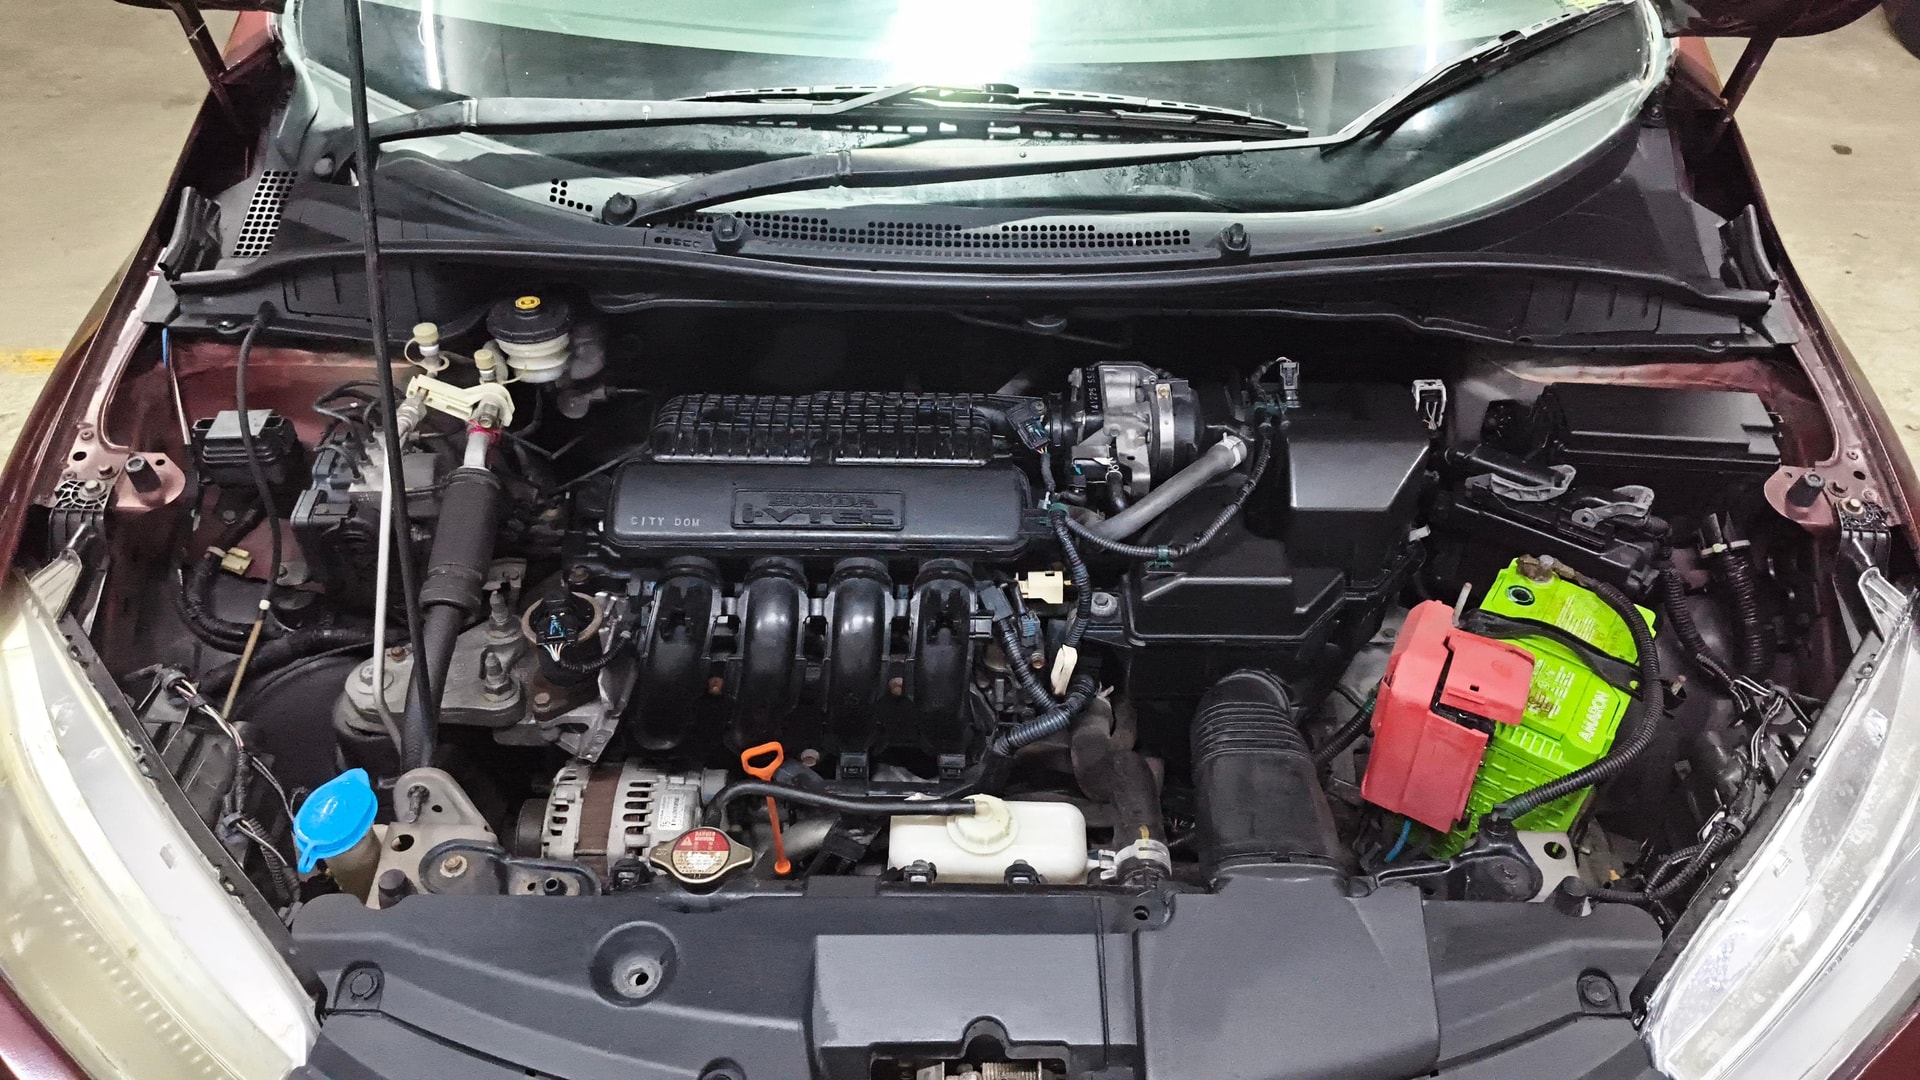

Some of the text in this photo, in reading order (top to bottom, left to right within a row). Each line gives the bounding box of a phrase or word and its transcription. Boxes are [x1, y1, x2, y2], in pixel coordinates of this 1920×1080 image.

[768, 493, 878, 508] HONDA
[630, 516, 700, 527] CITY DOM
[1578, 690, 1609, 743] AMARON
